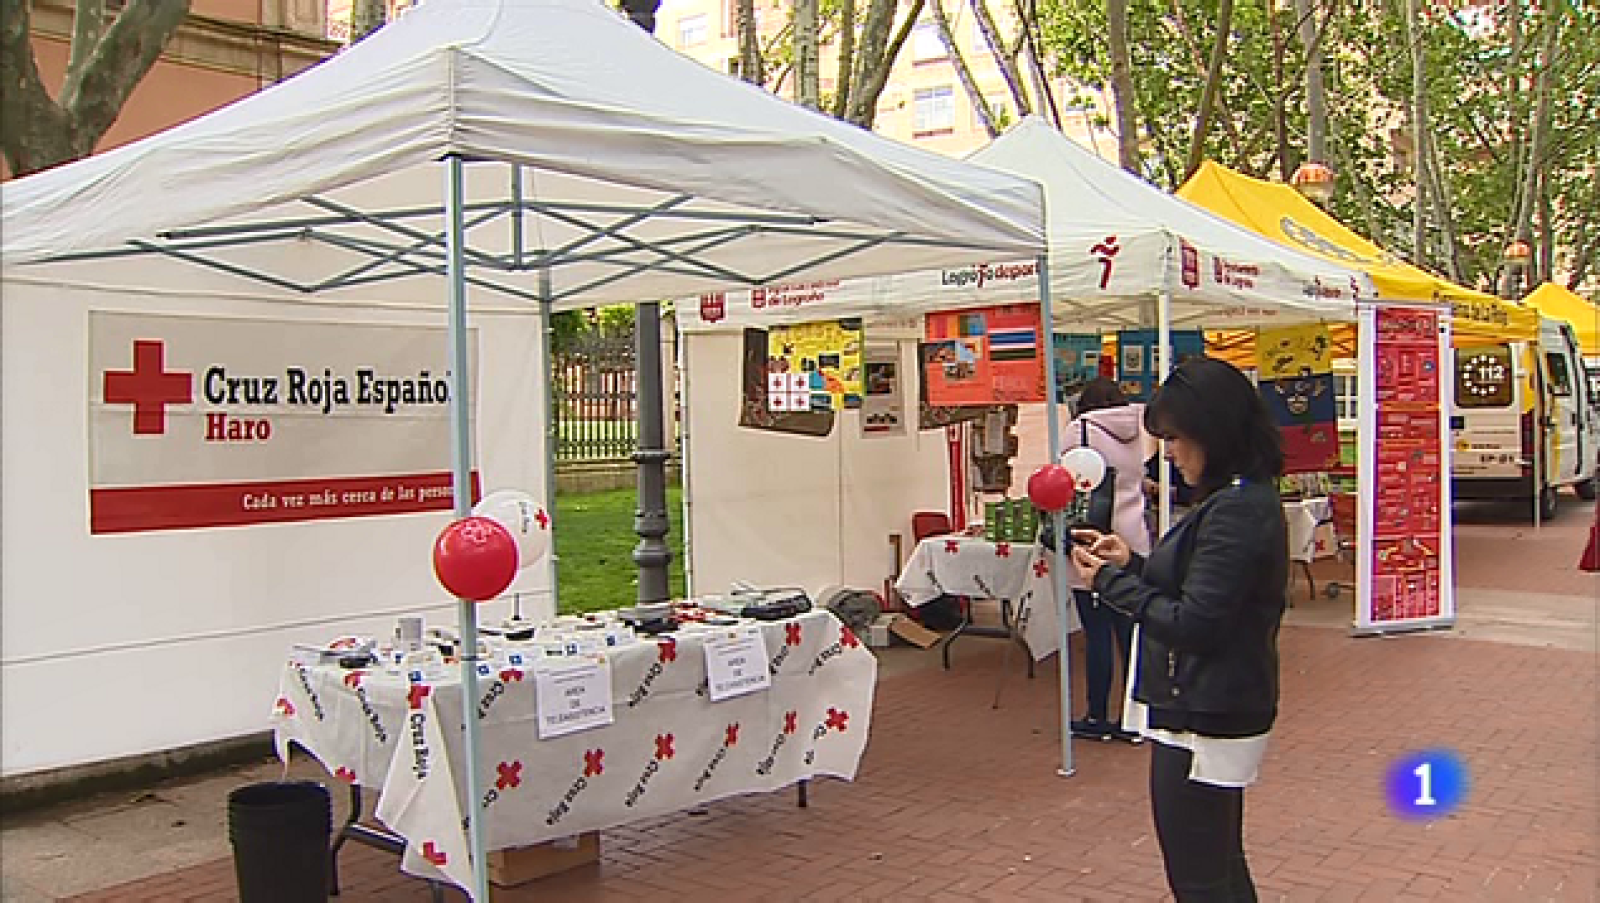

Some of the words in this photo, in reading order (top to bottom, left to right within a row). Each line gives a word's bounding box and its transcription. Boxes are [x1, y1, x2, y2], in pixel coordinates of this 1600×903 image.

[1479, 365, 1505, 379] 112
[204, 366, 279, 405] Cruz
[286, 368, 349, 414] Roja
[205, 413, 271, 441] Haro
[243, 492, 277, 510] Cada
[281, 495, 305, 508] vez
[381, 486, 394, 501] de
